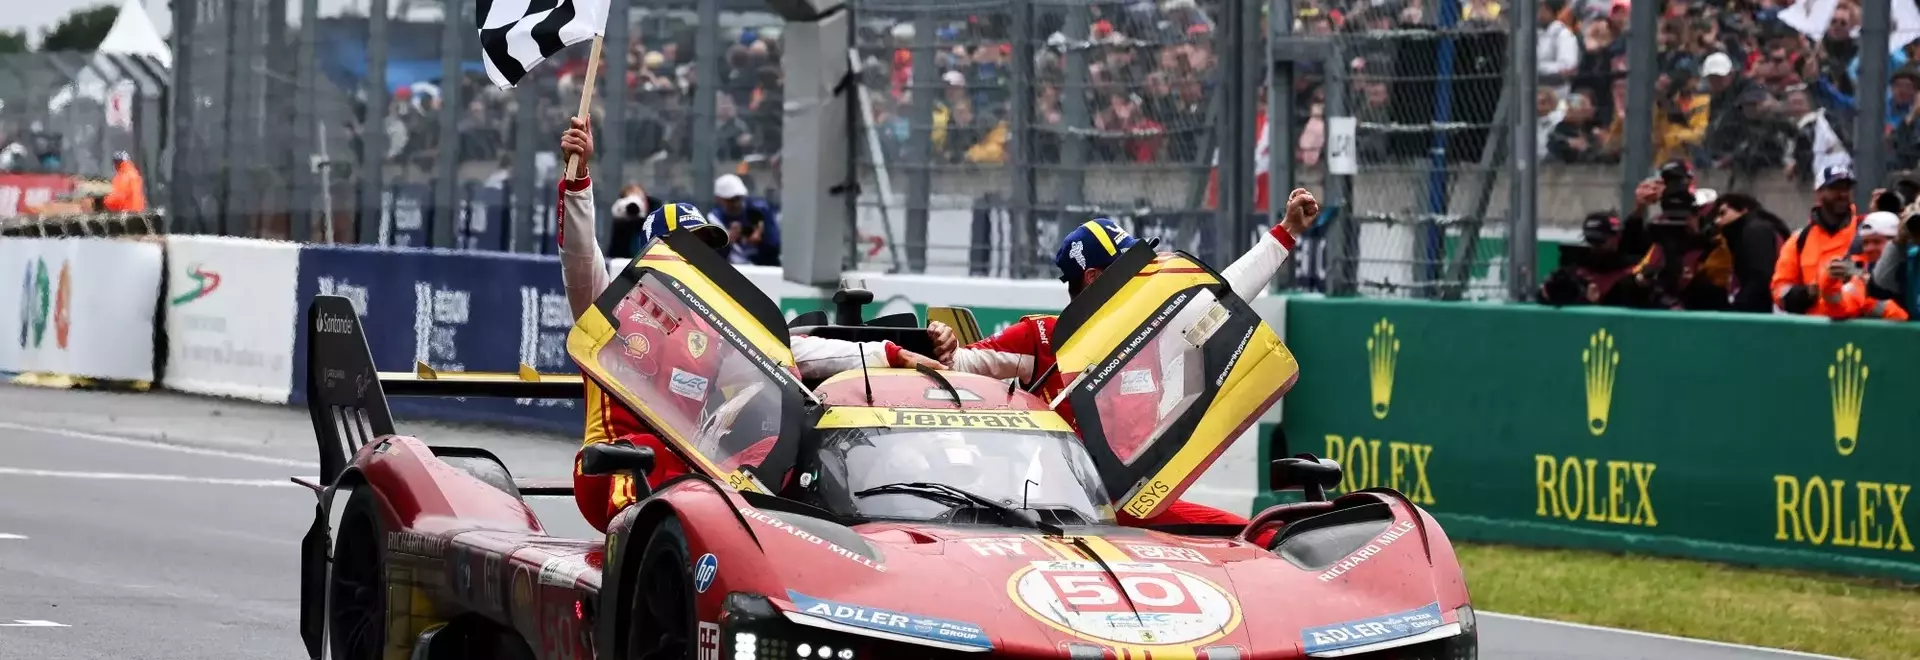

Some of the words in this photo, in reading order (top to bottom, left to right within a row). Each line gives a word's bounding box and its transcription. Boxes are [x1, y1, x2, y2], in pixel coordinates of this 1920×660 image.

[323, 312, 354, 335] Santander
[1036, 319, 1050, 345] Sabelt
[1098, 358, 1120, 380] FUOCO
[1130, 326, 1154, 349] MOLINA
[1162, 293, 1188, 318] NIELSEN
[686, 294, 710, 316] FUOCO
[723, 327, 748, 351] MOLINA
[761, 360, 788, 386] NIELSEN
[1215, 325, 1254, 387] @FerrariHypercar
[892, 409, 1041, 428] Ferrari
[1324, 433, 1436, 504] ROLEX
[1535, 453, 1658, 527] ROLEX
[1773, 474, 1915, 553] ROLEX
[387, 531, 423, 554] RICHARD
[738, 507, 824, 546] RICHARD
[827, 543, 888, 573] MILLE
[1317, 544, 1383, 583] RICHARD
[1375, 520, 1417, 546] MILLE
[696, 553, 717, 593] hp
[1052, 574, 1186, 608] 50
[805, 602, 911, 629] ADLER
[941, 622, 980, 633] PELZER
[1403, 613, 1432, 621] PELZER
[1411, 619, 1440, 628] GROUP
[939, 629, 978, 640] GROUP
[1311, 621, 1391, 645] ADLER
